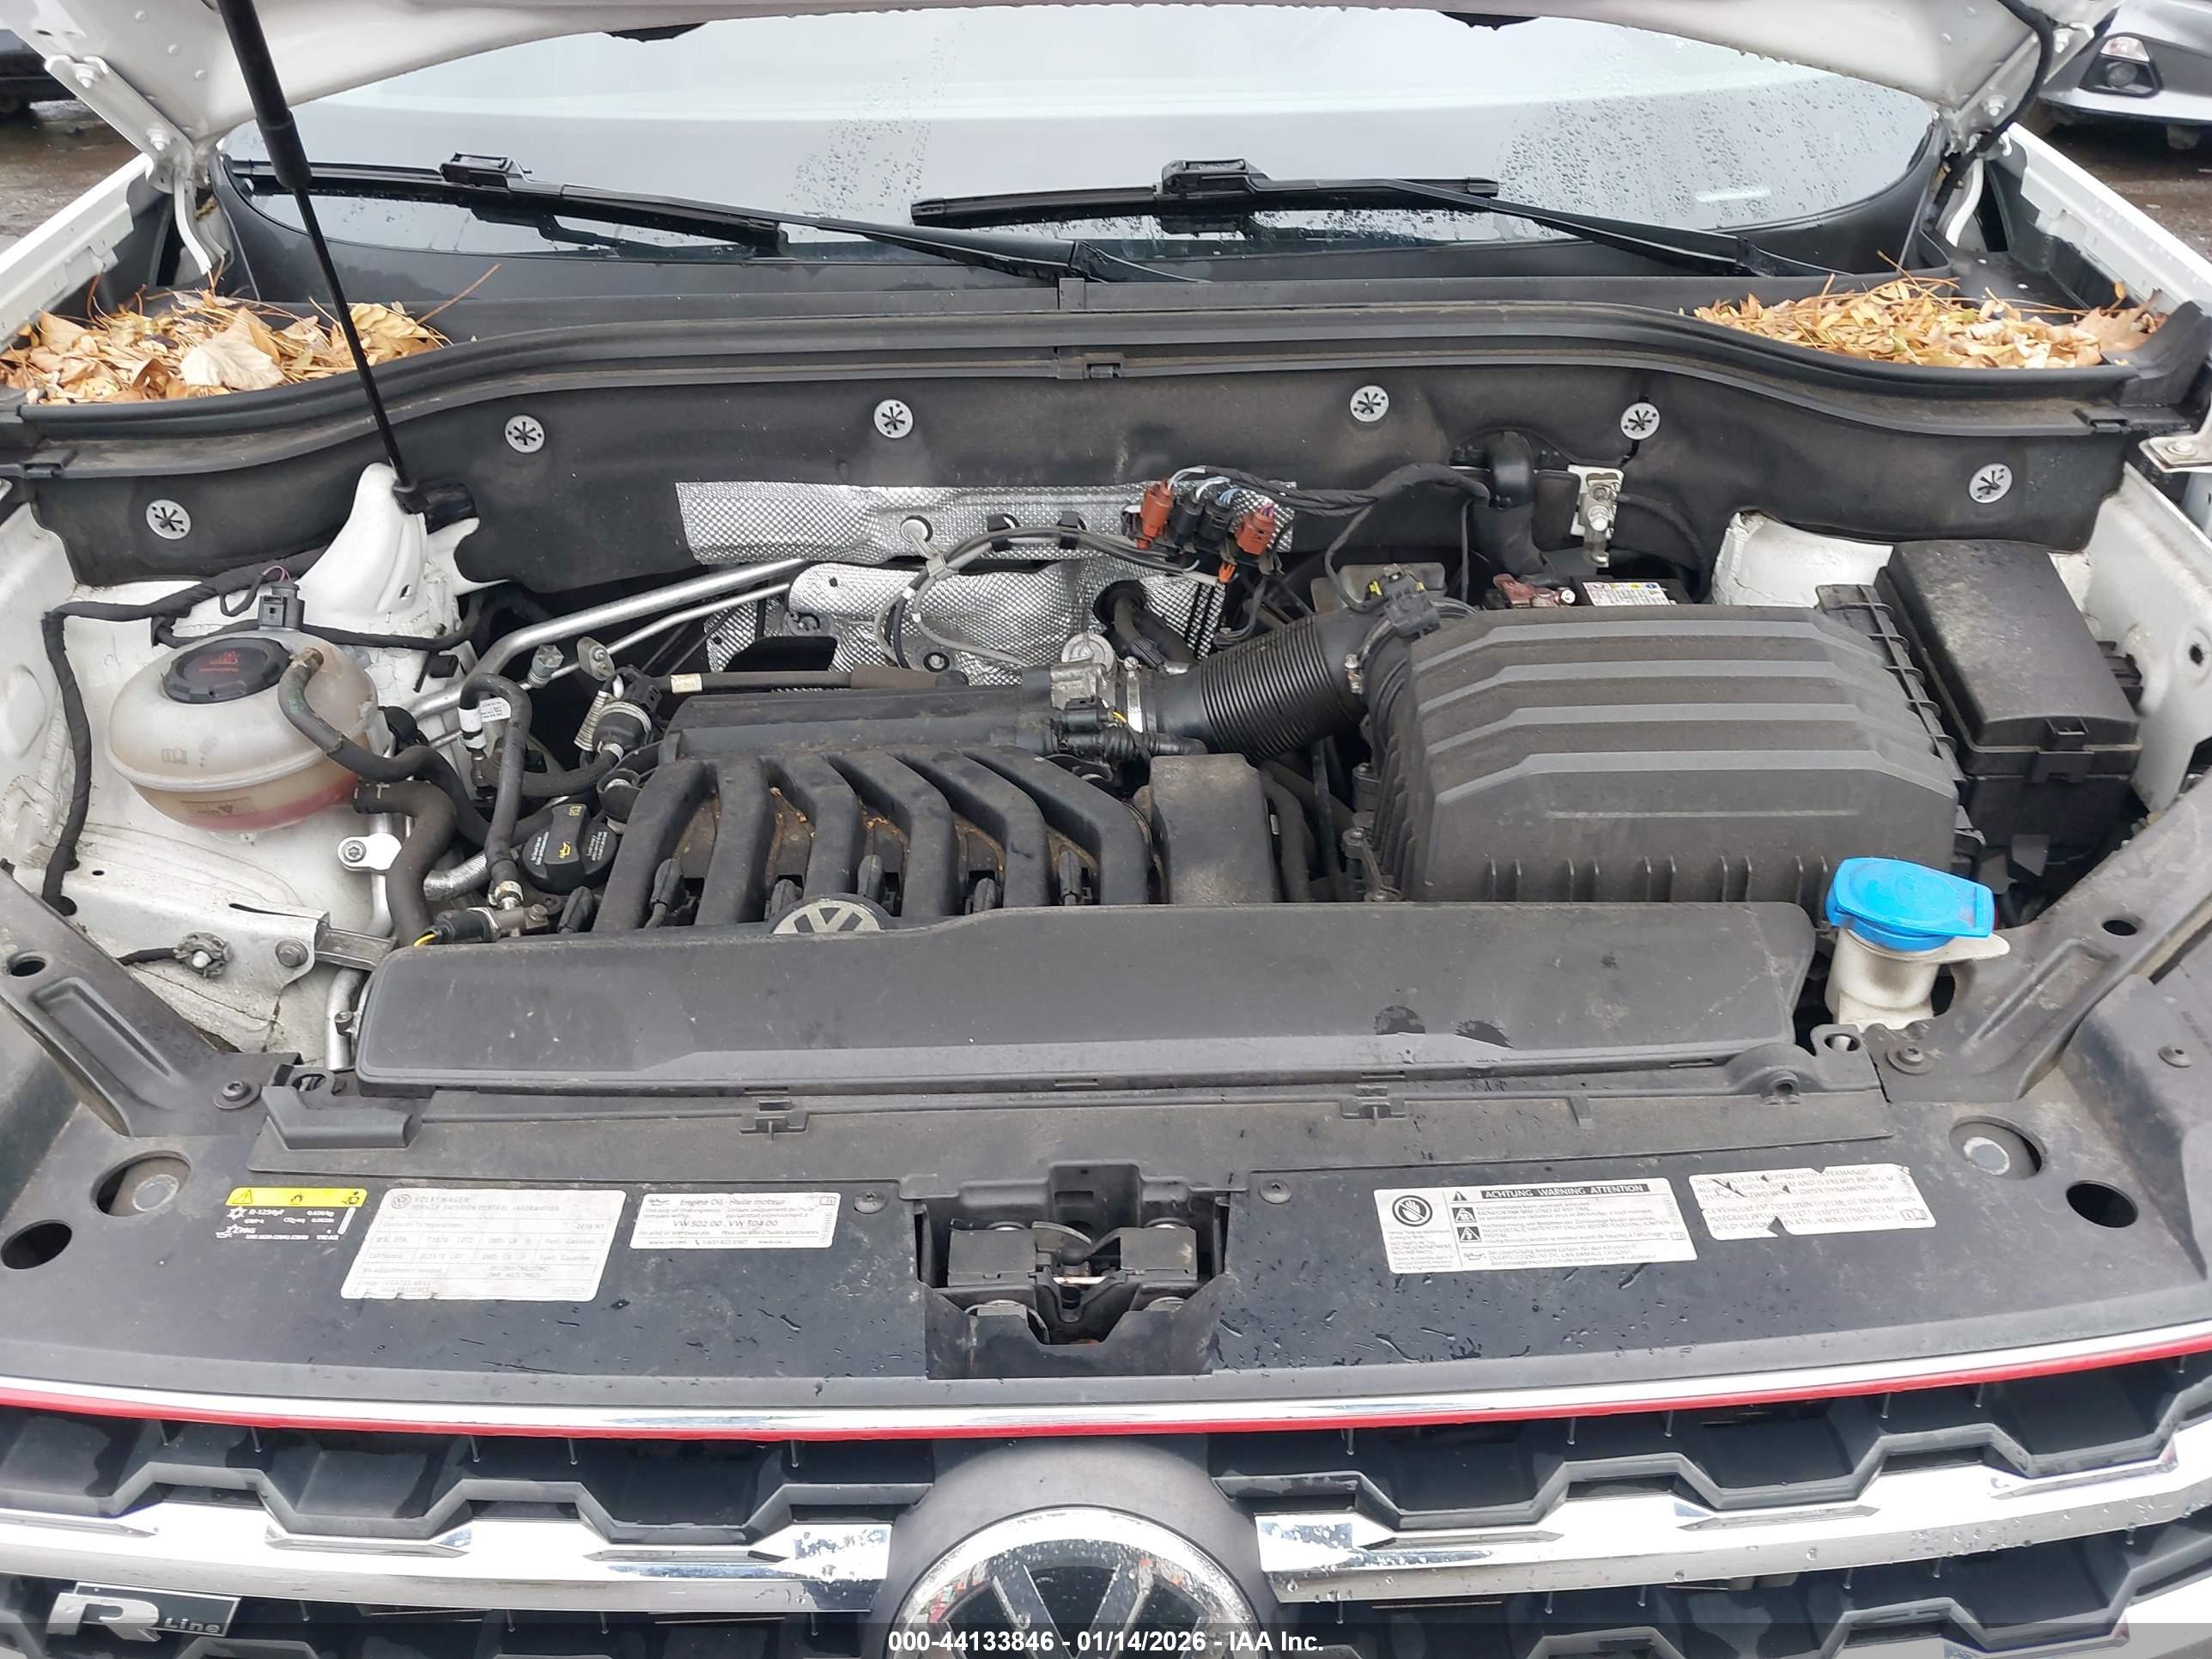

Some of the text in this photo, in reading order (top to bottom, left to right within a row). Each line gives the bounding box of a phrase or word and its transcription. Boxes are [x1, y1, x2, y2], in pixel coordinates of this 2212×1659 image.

[1484, 1184, 1644, 1198] ACHTUNG WARNING ATTENTION
[46, 1593, 221, 1642] R Line
